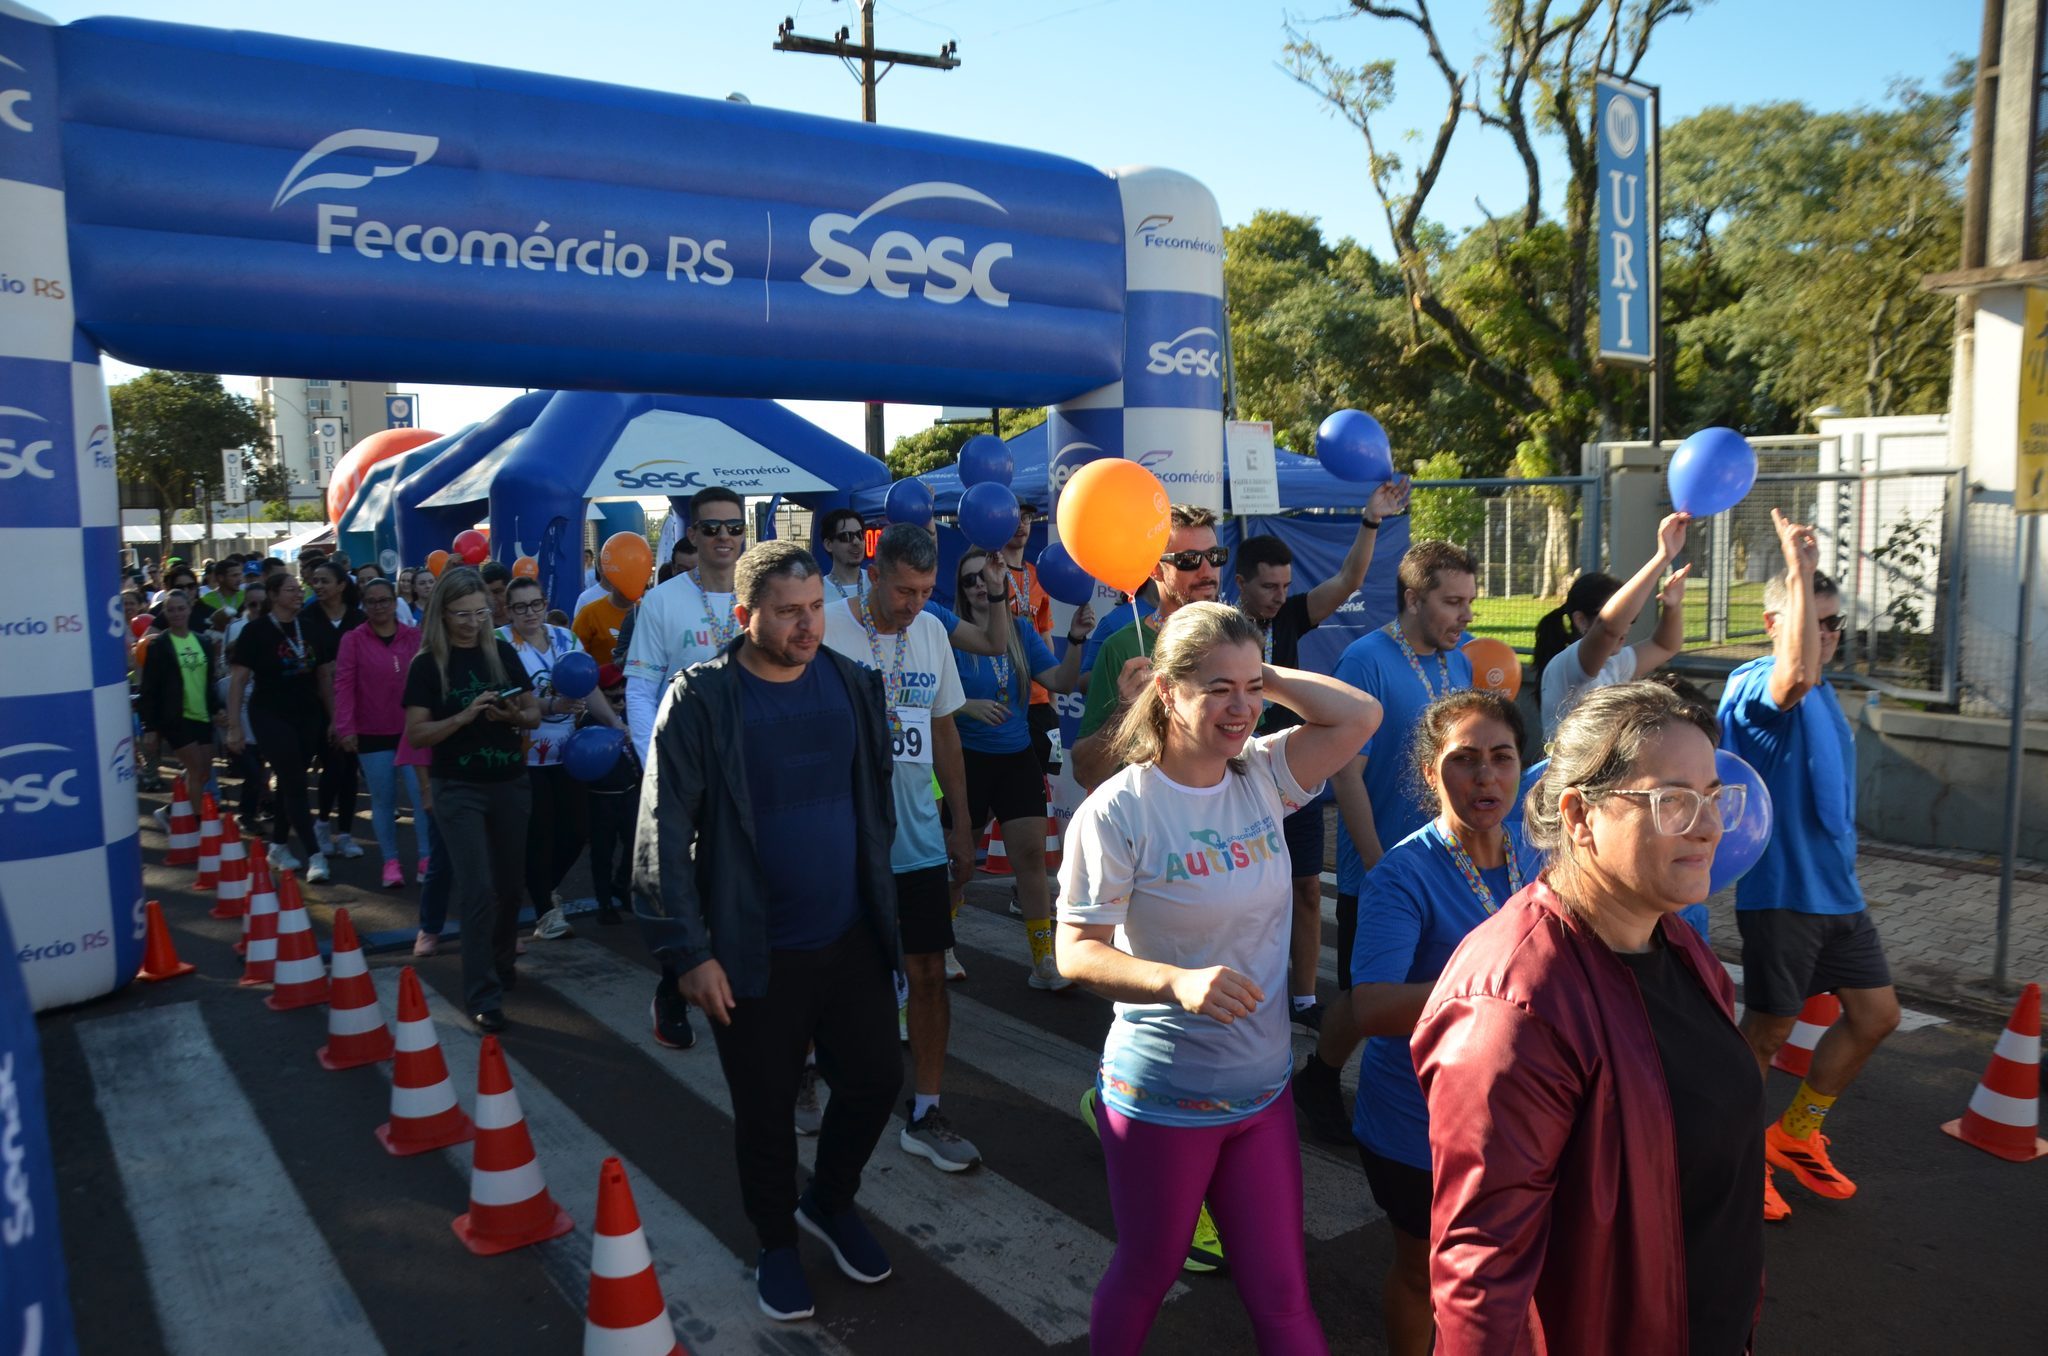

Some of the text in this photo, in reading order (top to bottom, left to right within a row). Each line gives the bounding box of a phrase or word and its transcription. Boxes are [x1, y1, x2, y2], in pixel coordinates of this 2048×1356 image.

[317, 203, 735, 286] Fecomércio RS
[1144, 234, 1216, 255] Fecomércio
[801, 212, 1013, 308] Sesc
[1608, 169, 1639, 349] URI
[33, 277, 66, 299] RS
[1146, 342, 1219, 378] Sesc
[613, 469, 707, 489] Sesc
[713, 465, 790, 477] Fecomércio
[1150, 469, 1215, 484] ecomércio
[226, 466, 240, 500] URI
[54, 615, 83, 633] RS
[82, 930, 108, 950] RS
